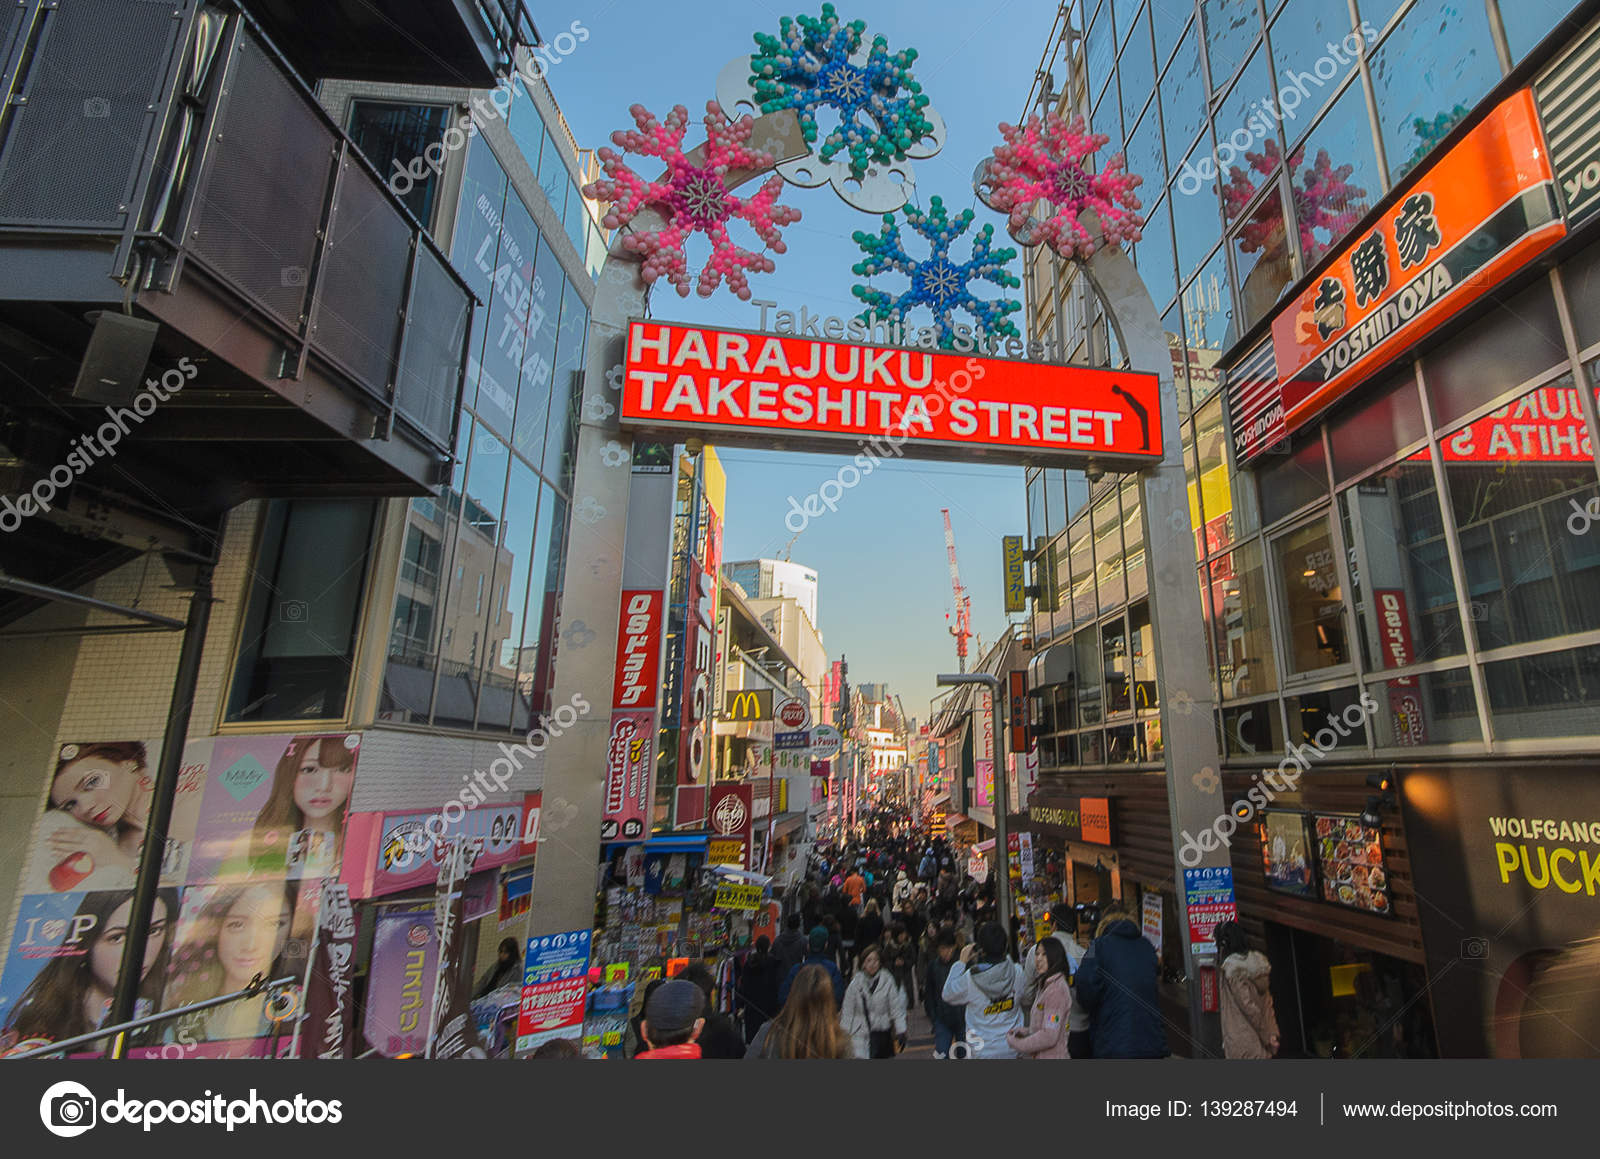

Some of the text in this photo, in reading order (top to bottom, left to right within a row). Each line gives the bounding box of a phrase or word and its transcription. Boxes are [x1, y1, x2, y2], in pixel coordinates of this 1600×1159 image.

[475, 233, 545, 341] LASER
[498, 312, 550, 388] TRAP
[752, 300, 1058, 361] Takeshita Street
[1320, 262, 1453, 381] YOSHINOYA
[629, 324, 933, 389] HARAJUKU
[628, 370, 1122, 446] TAKESHITA STREET
[1235, 404, 1285, 450] YOSHINOYA
[1007, 537, 1022, 601] コインロッカー
[620, 594, 652, 705] OSドラッグ
[629, 765, 639, 798] STUDIO
[638, 737, 651, 811] ENTERTAINMENT
[1082, 813, 1108, 830] EXPRESS
[1489, 816, 1600, 845] WOLFGANG
[1496, 842, 1600, 897] PUCK
